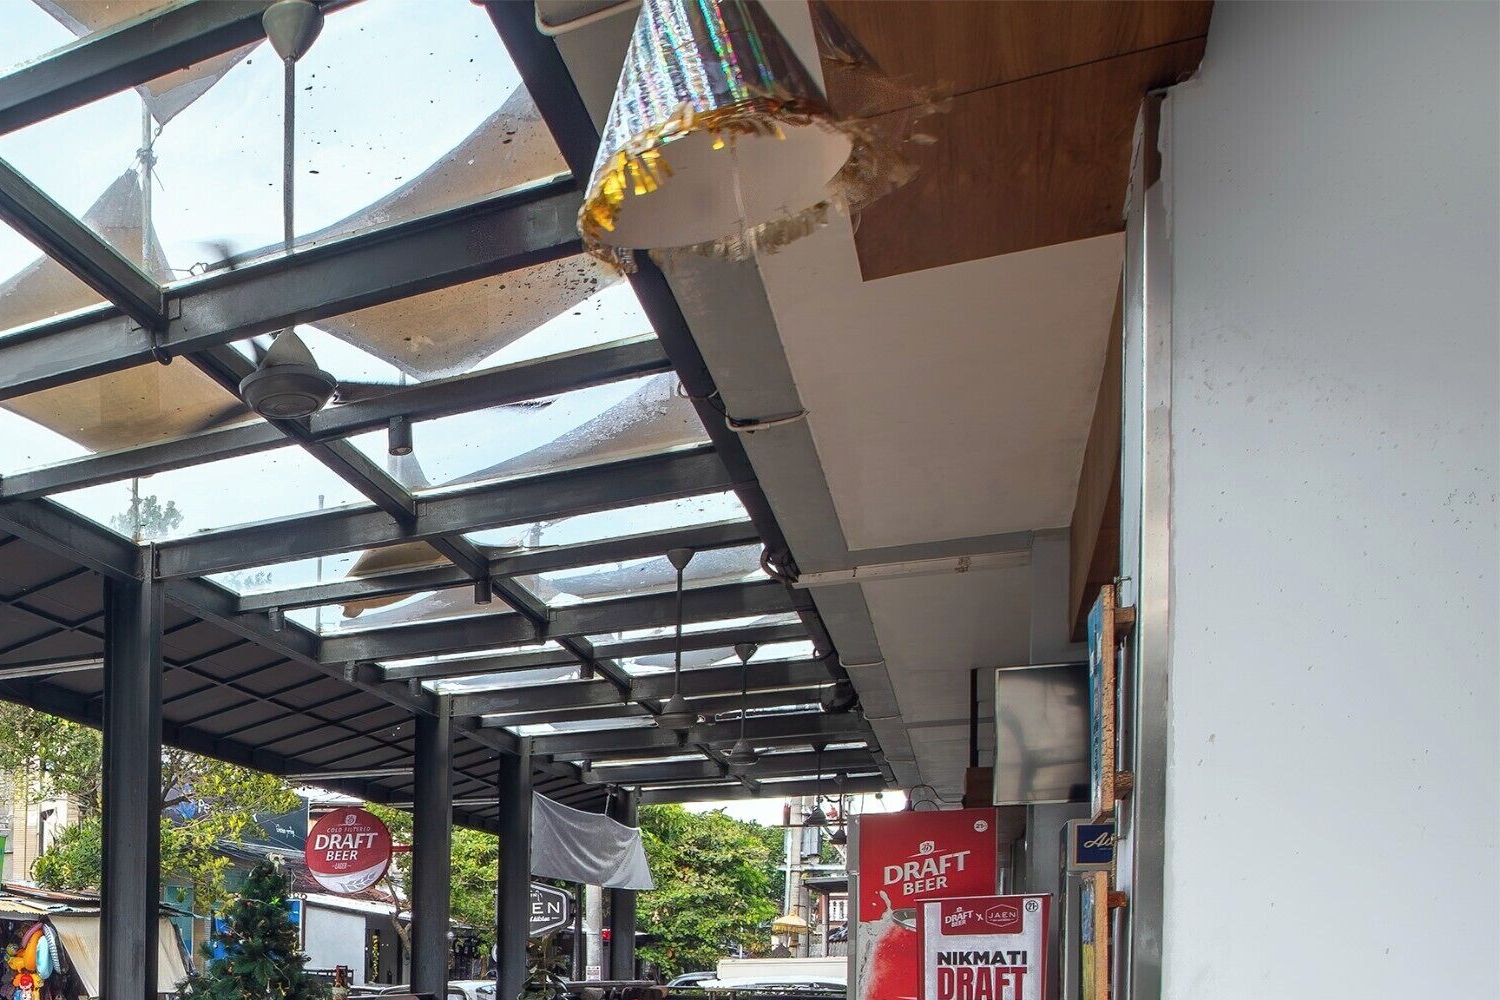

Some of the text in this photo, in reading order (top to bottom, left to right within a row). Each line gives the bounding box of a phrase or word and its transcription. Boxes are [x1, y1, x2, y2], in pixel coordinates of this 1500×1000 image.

[314, 832, 378, 850] DRAFT
[326, 850, 358, 862] BEER
[884, 850, 970, 886] DRAFT
[903, 876, 948, 896] BEER
[945, 910, 974, 924] DRAFT
[988, 911, 1016, 919] JAEN
[951, 920, 967, 928] BEER
[937, 951, 1027, 966] NIKMATI
[937, 967, 1027, 1000] DRAFT
